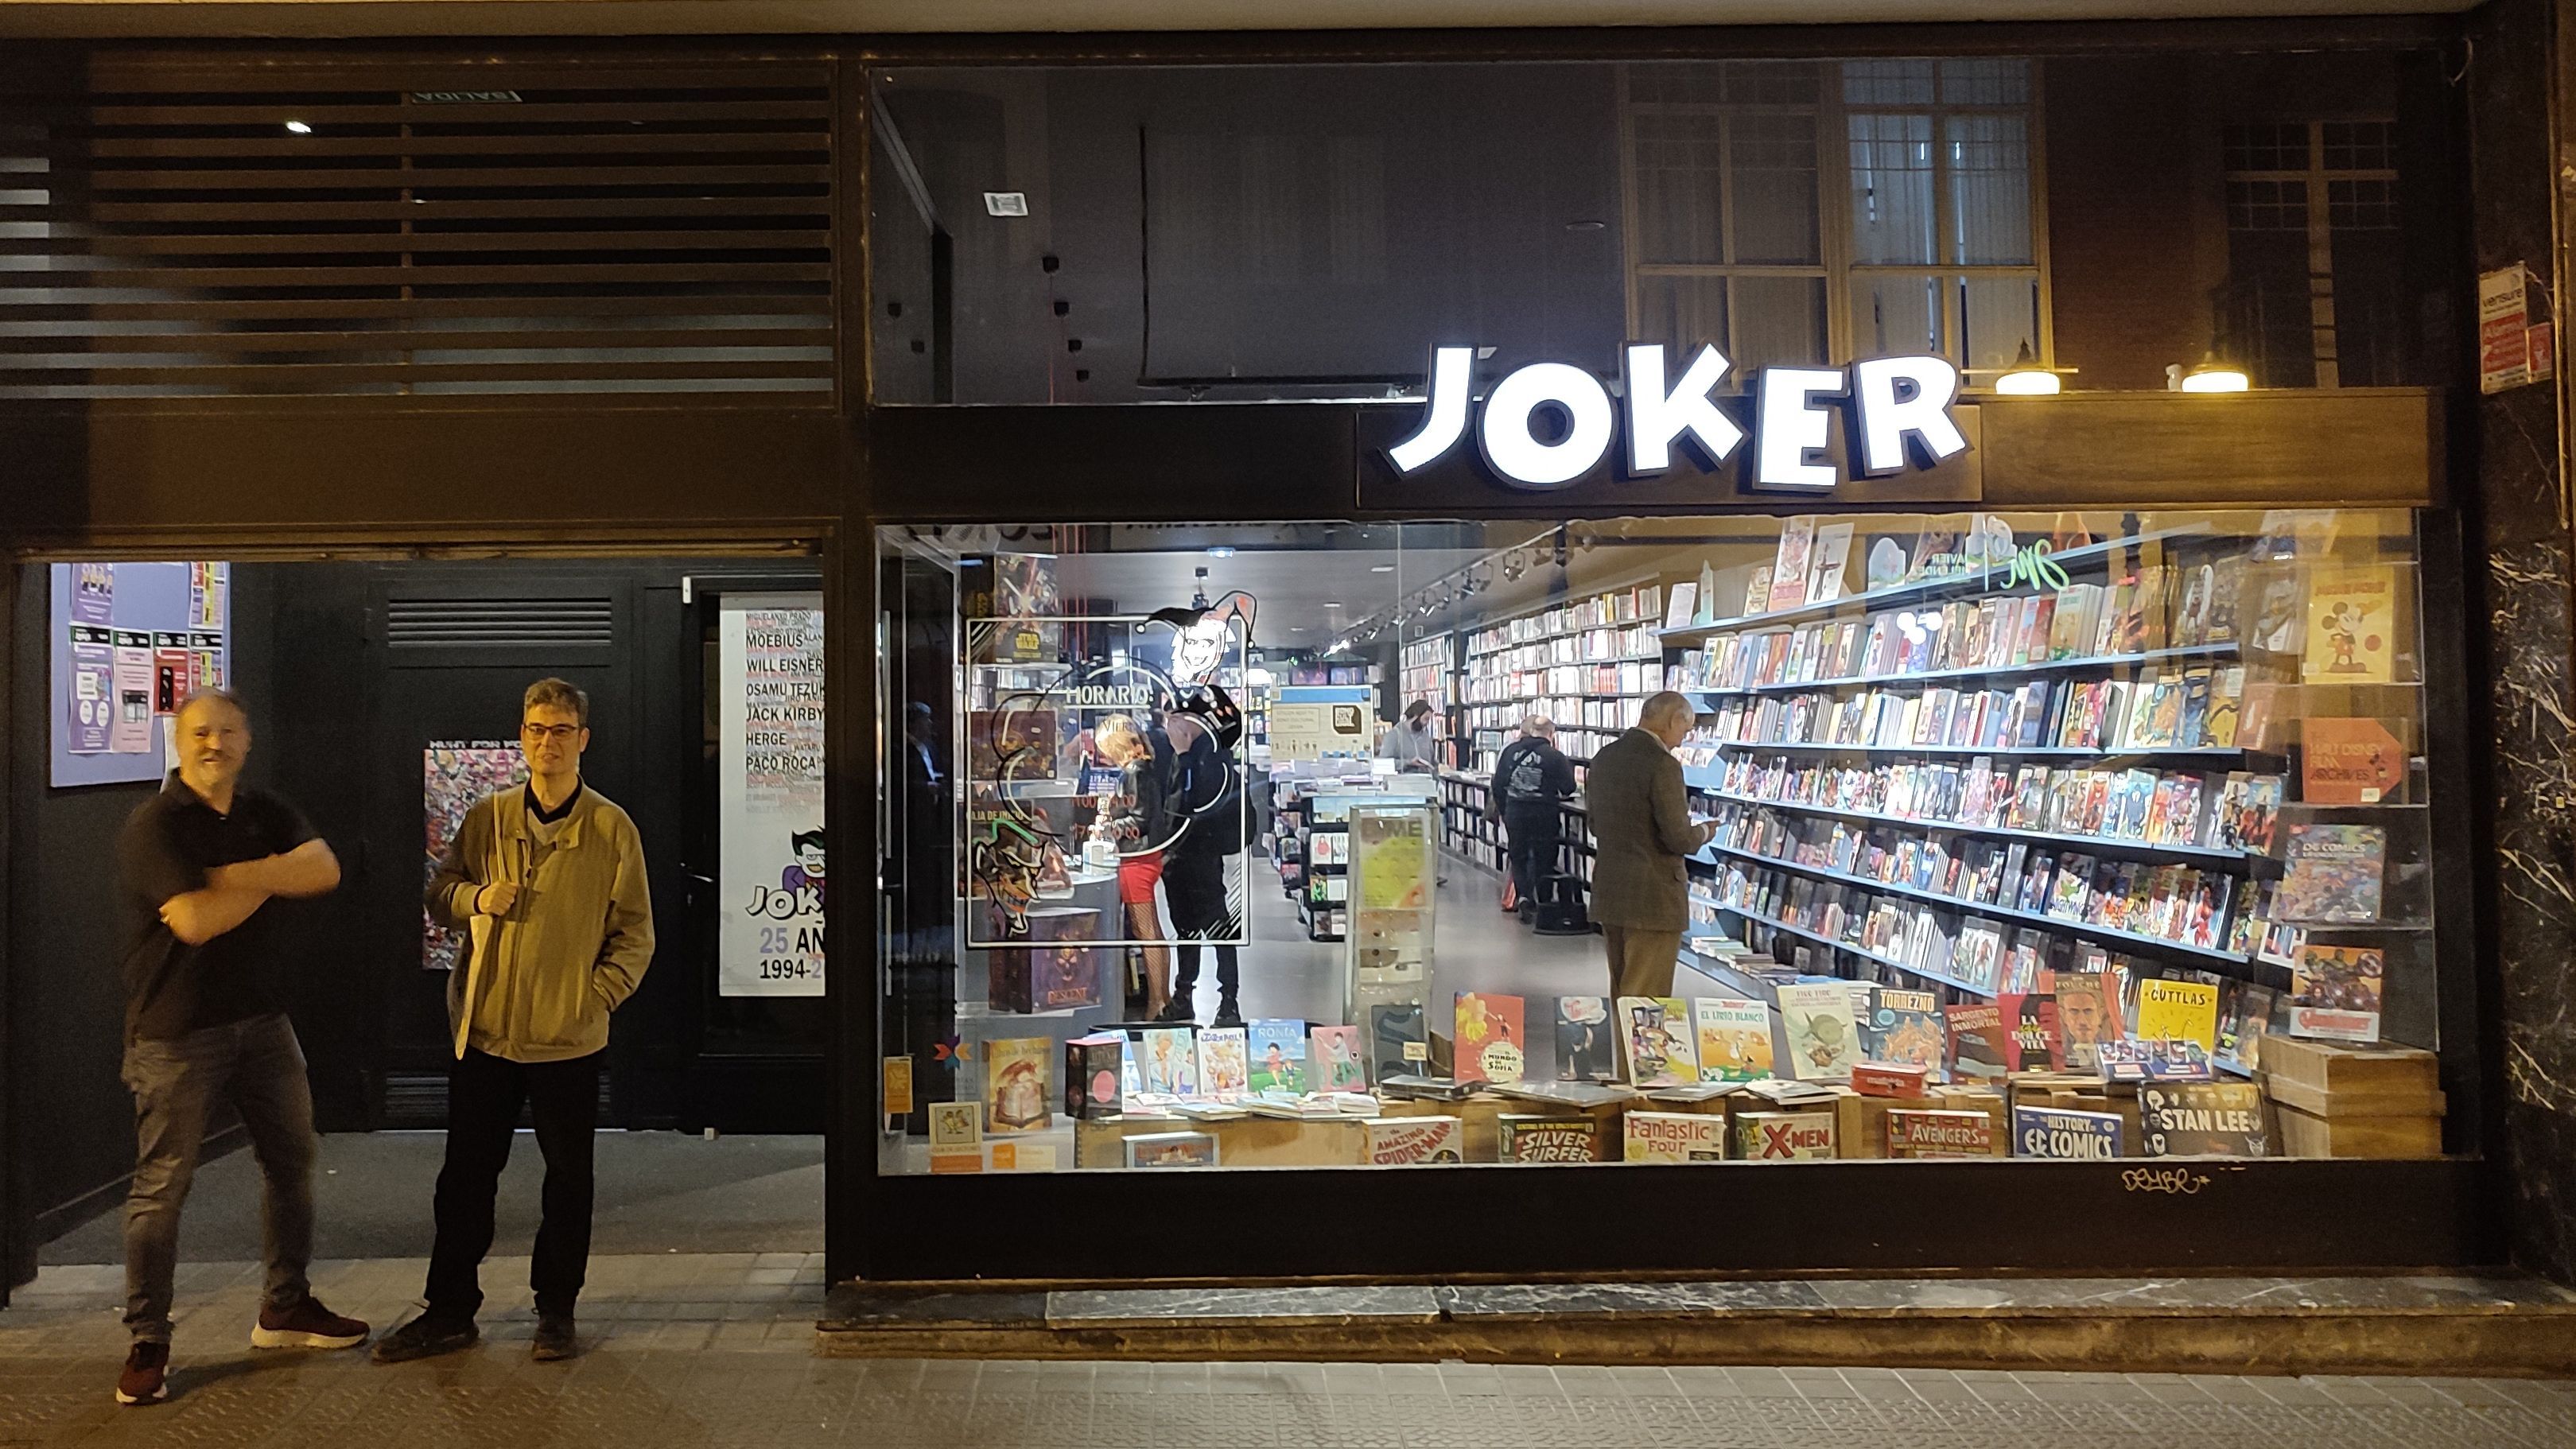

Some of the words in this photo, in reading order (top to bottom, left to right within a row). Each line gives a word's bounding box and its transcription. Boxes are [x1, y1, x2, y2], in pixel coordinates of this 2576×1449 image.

[1381, 340, 1974, 491] JOKER
[746, 634, 803, 648] MOEBIUS
[746, 658, 775, 672] WILL
[779, 658, 824, 672] EISNER
[746, 682, 787, 696] OSAMU
[790, 682, 825, 697] TEZUK
[746, 707, 780, 721] JACK
[783, 707, 825, 721] KIRBY
[746, 732, 787, 746] HERGE
[746, 756, 779, 771] PACO
[782, 756, 816, 771] ROCA
[969, 810, 986, 821] AJA
[745, 885, 824, 920] JOK
[760, 927, 788, 954] 25
[795, 919, 825, 954] AÑ
[760, 958, 822, 980] 1994-2
[1879, 993, 1935, 1012] TORREZNO
[2150, 988, 2207, 1006] CUTTLAS
[1735, 1012, 1764, 1023] BLANCO
[1949, 1008, 1999, 1022] SARGENTO
[1951, 1017, 2002, 1032] INMORTAL
[1628, 1117, 1710, 1140] Fantastic
[2047, 1115, 2092, 1132] HISTORY
[2160, 1109, 2213, 1132] STAN
[2216, 1109, 2250, 1132] LEE
[1373, 1121, 1451, 1164] SPIDER-MAN
[1377, 1127, 1425, 1152] AMAZING
[1522, 1131, 1591, 1150] SILVER
[1762, 1122, 1830, 1159] X-MEN
[1910, 1124, 1980, 1144] AVENGERS
[2050, 1130, 2113, 1160] COMICS
[1519, 1147, 1594, 1164] SURFER
